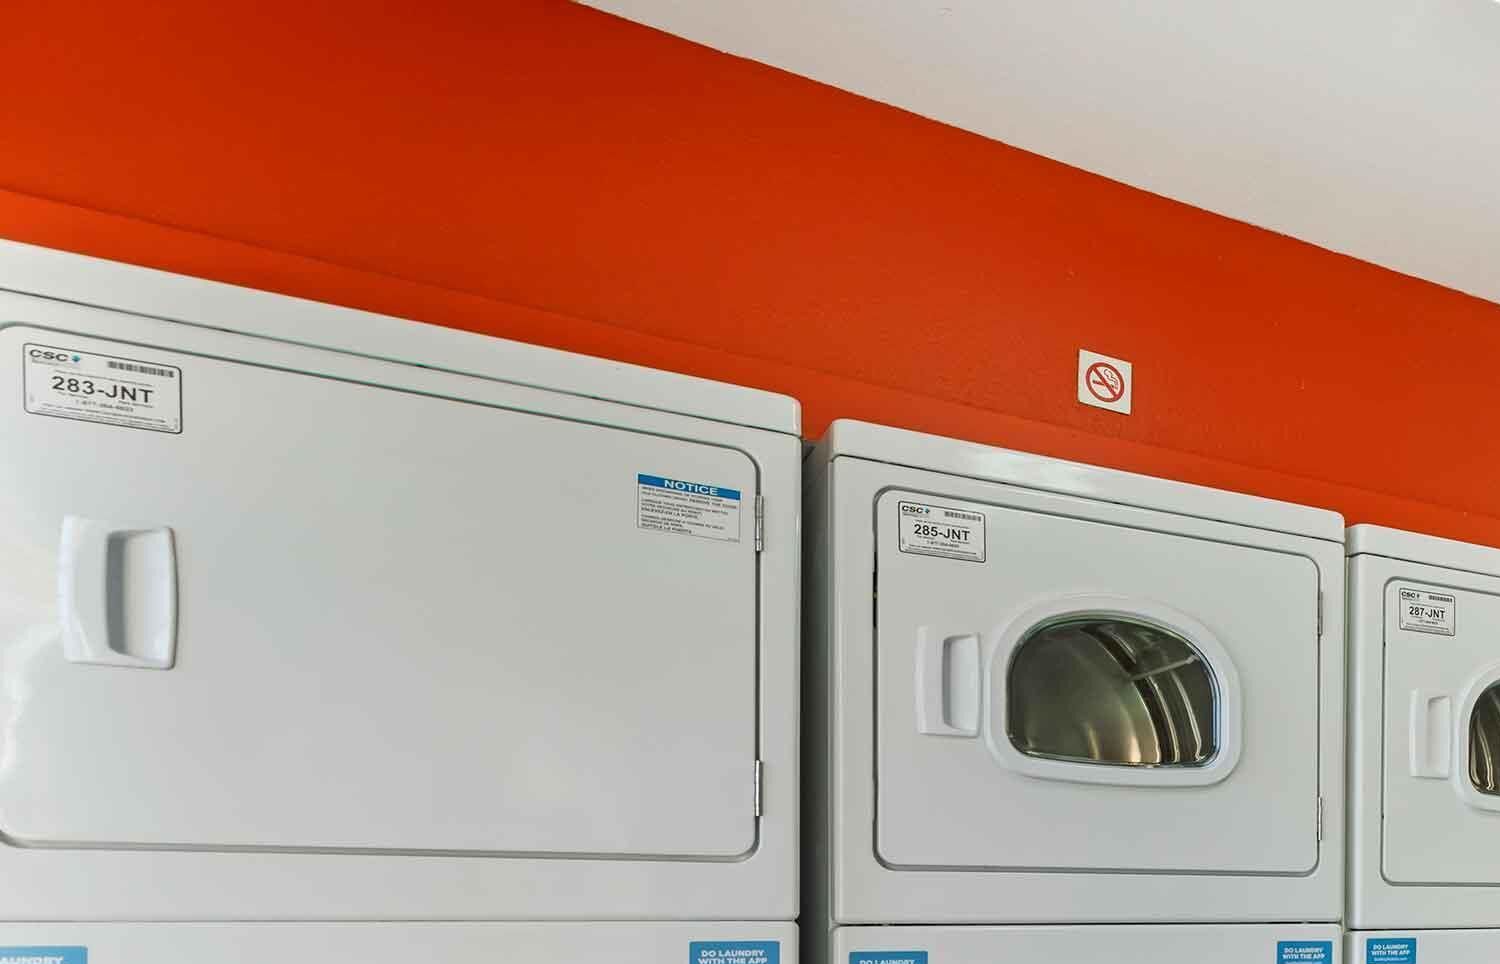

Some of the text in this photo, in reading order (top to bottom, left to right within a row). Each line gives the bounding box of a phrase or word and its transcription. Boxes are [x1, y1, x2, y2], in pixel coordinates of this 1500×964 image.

[29, 349, 68, 362] CSC
[52, 376, 154, 403] 283-JNT
[664, 480, 718, 495] NOTICE
[902, 505, 923, 513] CSC
[914, 524, 970, 541] 285-JNT
[1409, 607, 1445, 618] 287-JNT
[0, 956, 64, 964] AUNDRY
[748, 957, 767, 964] APP
